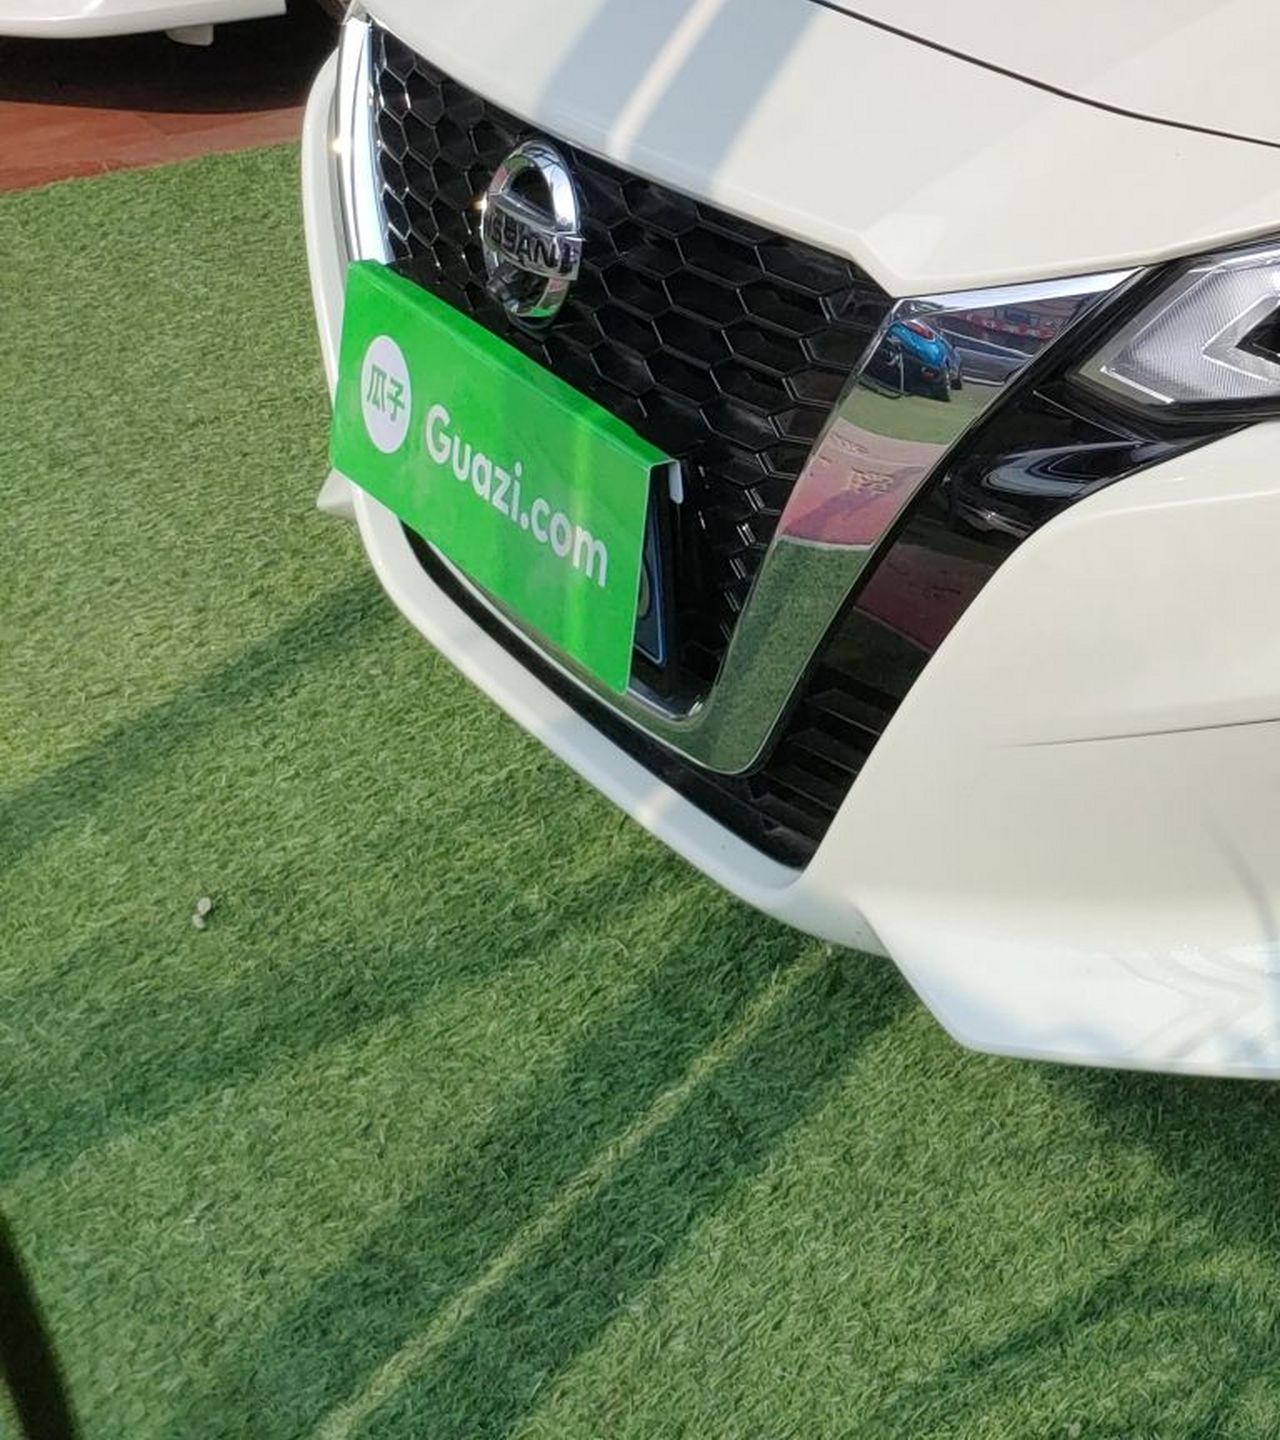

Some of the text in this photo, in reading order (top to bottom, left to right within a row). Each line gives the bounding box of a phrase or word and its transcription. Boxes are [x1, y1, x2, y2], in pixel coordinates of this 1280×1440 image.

[484, 210, 559, 268] SSAN
[366, 363, 405, 422] 瓜子
[426, 404, 608, 587] Guazi.com
